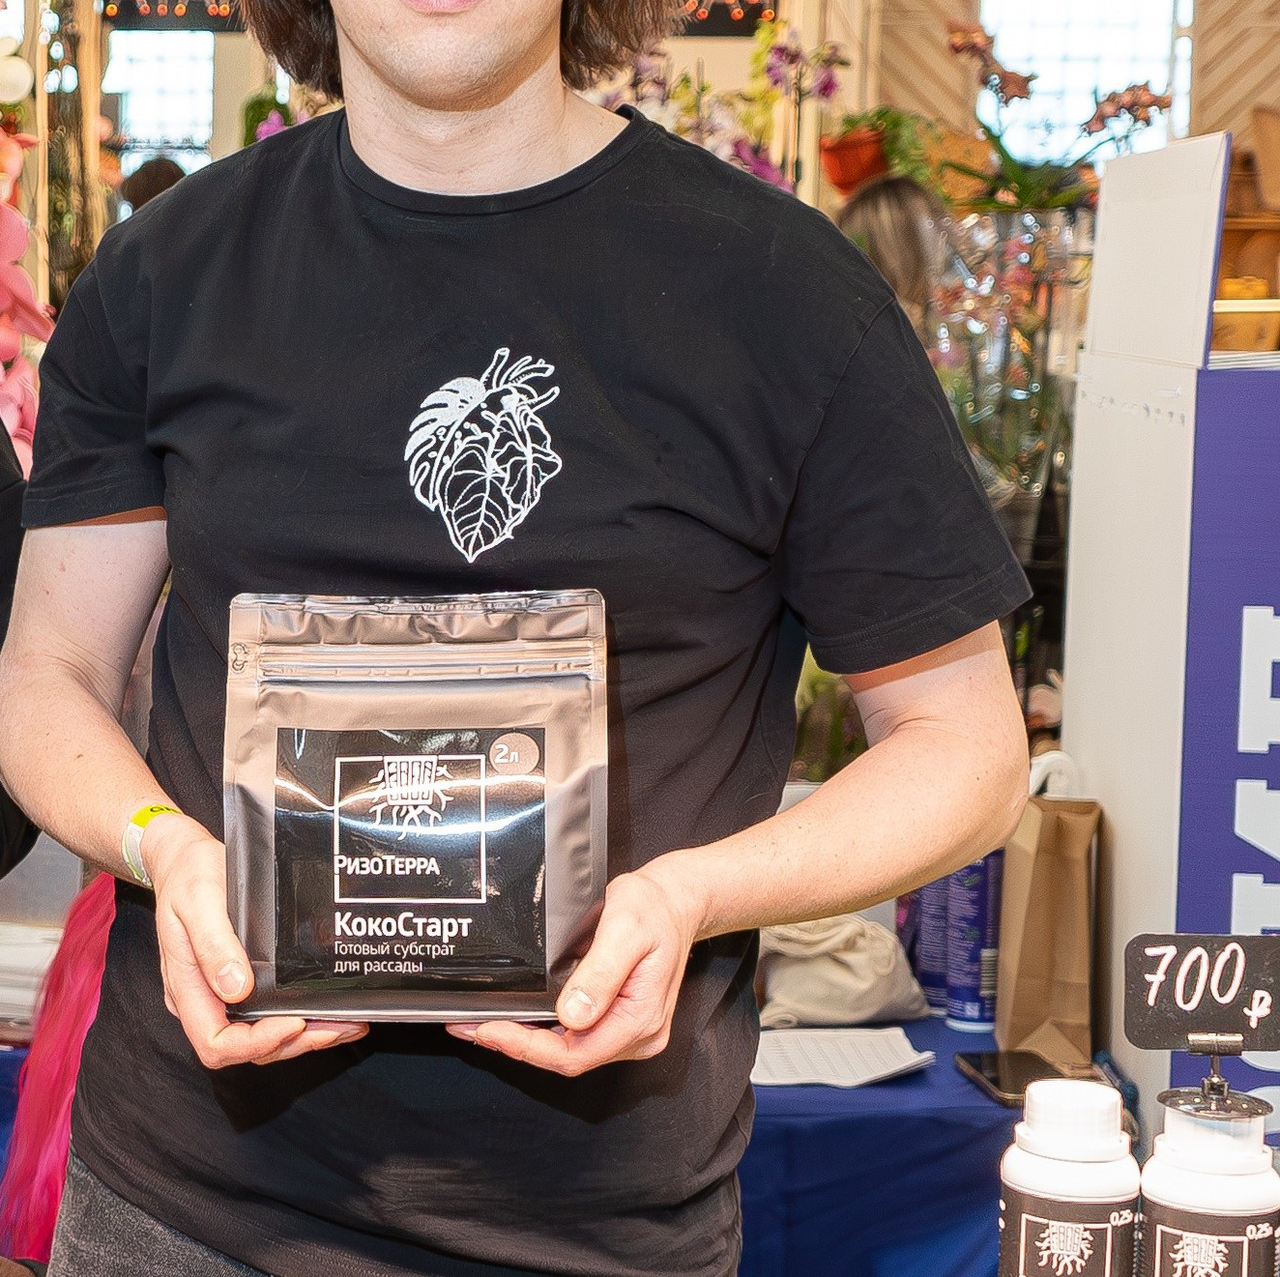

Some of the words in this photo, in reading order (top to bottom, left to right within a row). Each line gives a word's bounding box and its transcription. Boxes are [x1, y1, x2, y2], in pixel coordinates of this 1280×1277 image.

[494, 743, 520, 765] 2л
[333, 910, 473, 944] КокоСтарт
[333, 940, 391, 957] Готовый
[393, 942, 456, 960] субстрат
[333, 960, 360, 974] для
[363, 961, 423, 976] рассады
